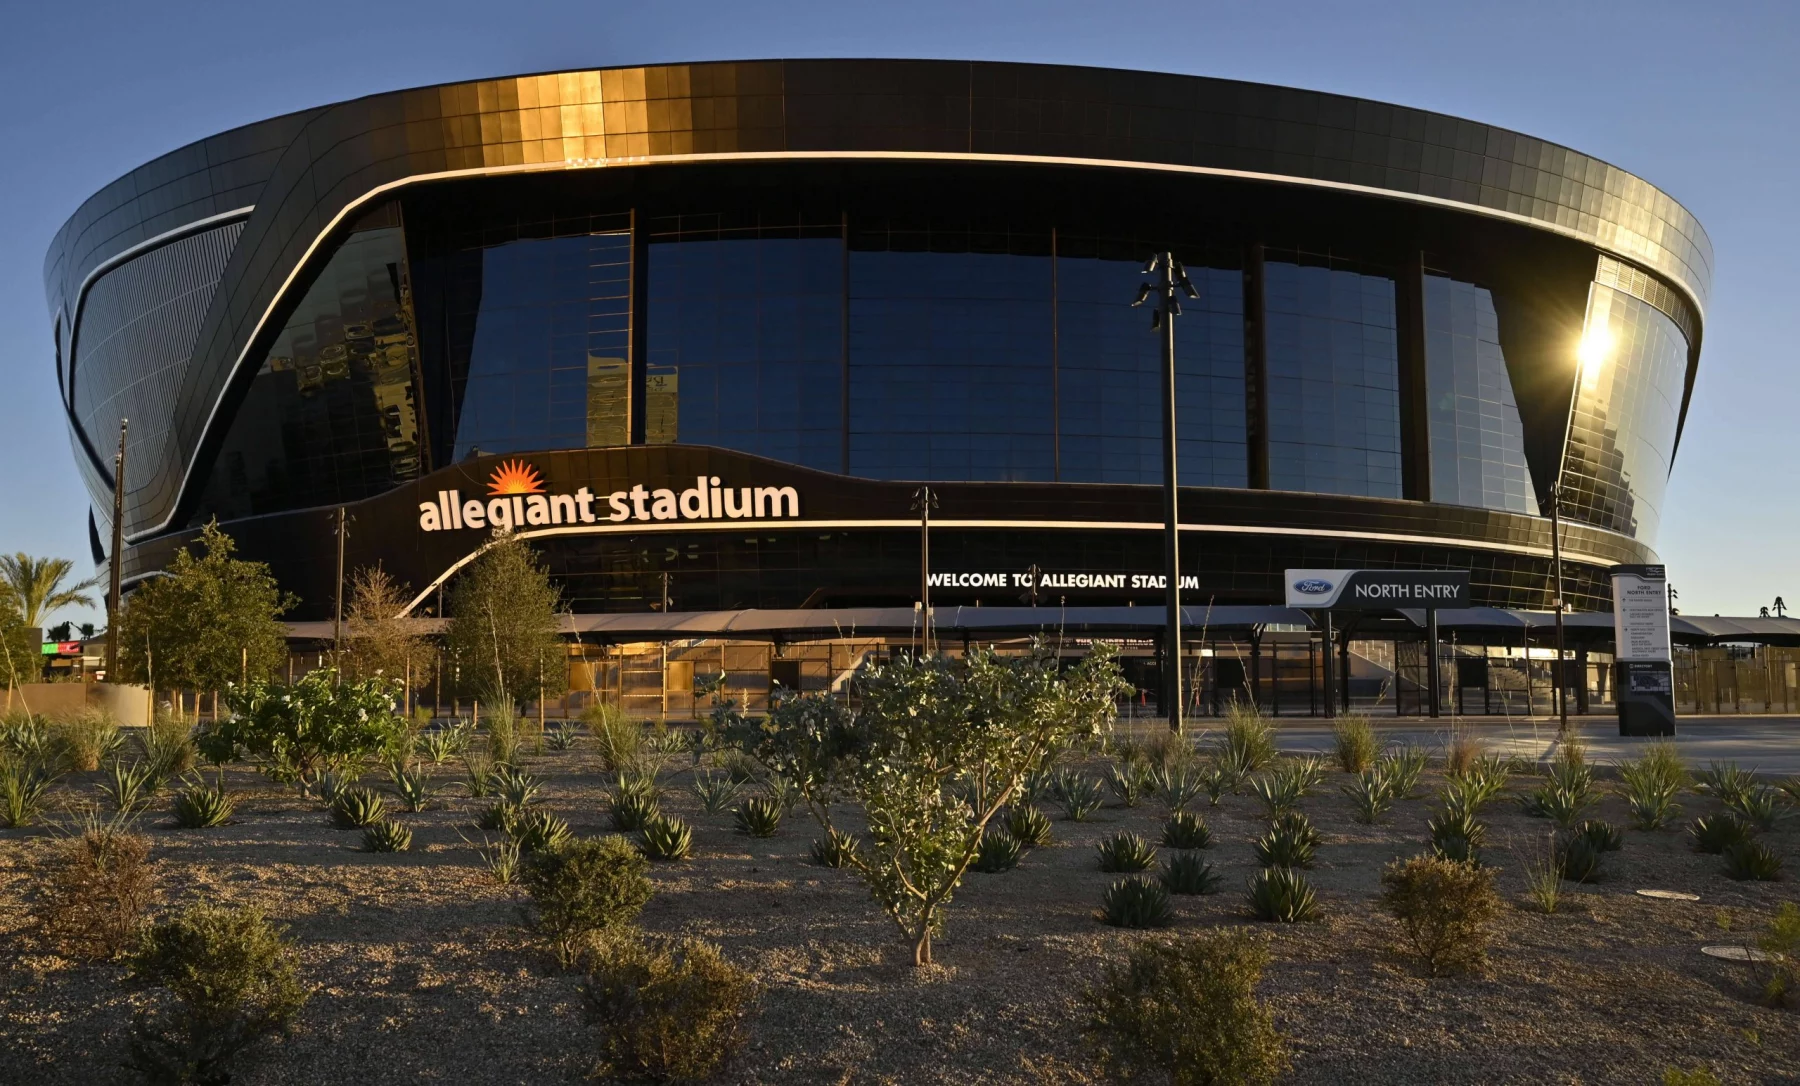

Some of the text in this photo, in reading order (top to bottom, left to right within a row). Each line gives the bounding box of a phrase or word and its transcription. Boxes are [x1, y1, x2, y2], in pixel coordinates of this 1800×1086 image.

[420, 476, 799, 535] allegiant stadium
[927, 573, 1200, 590] WELCOME TO ALLEGIANT STADUM
[1301, 581, 1325, 592] Ford
[1355, 584, 1460, 598] NORTH ENTRY
